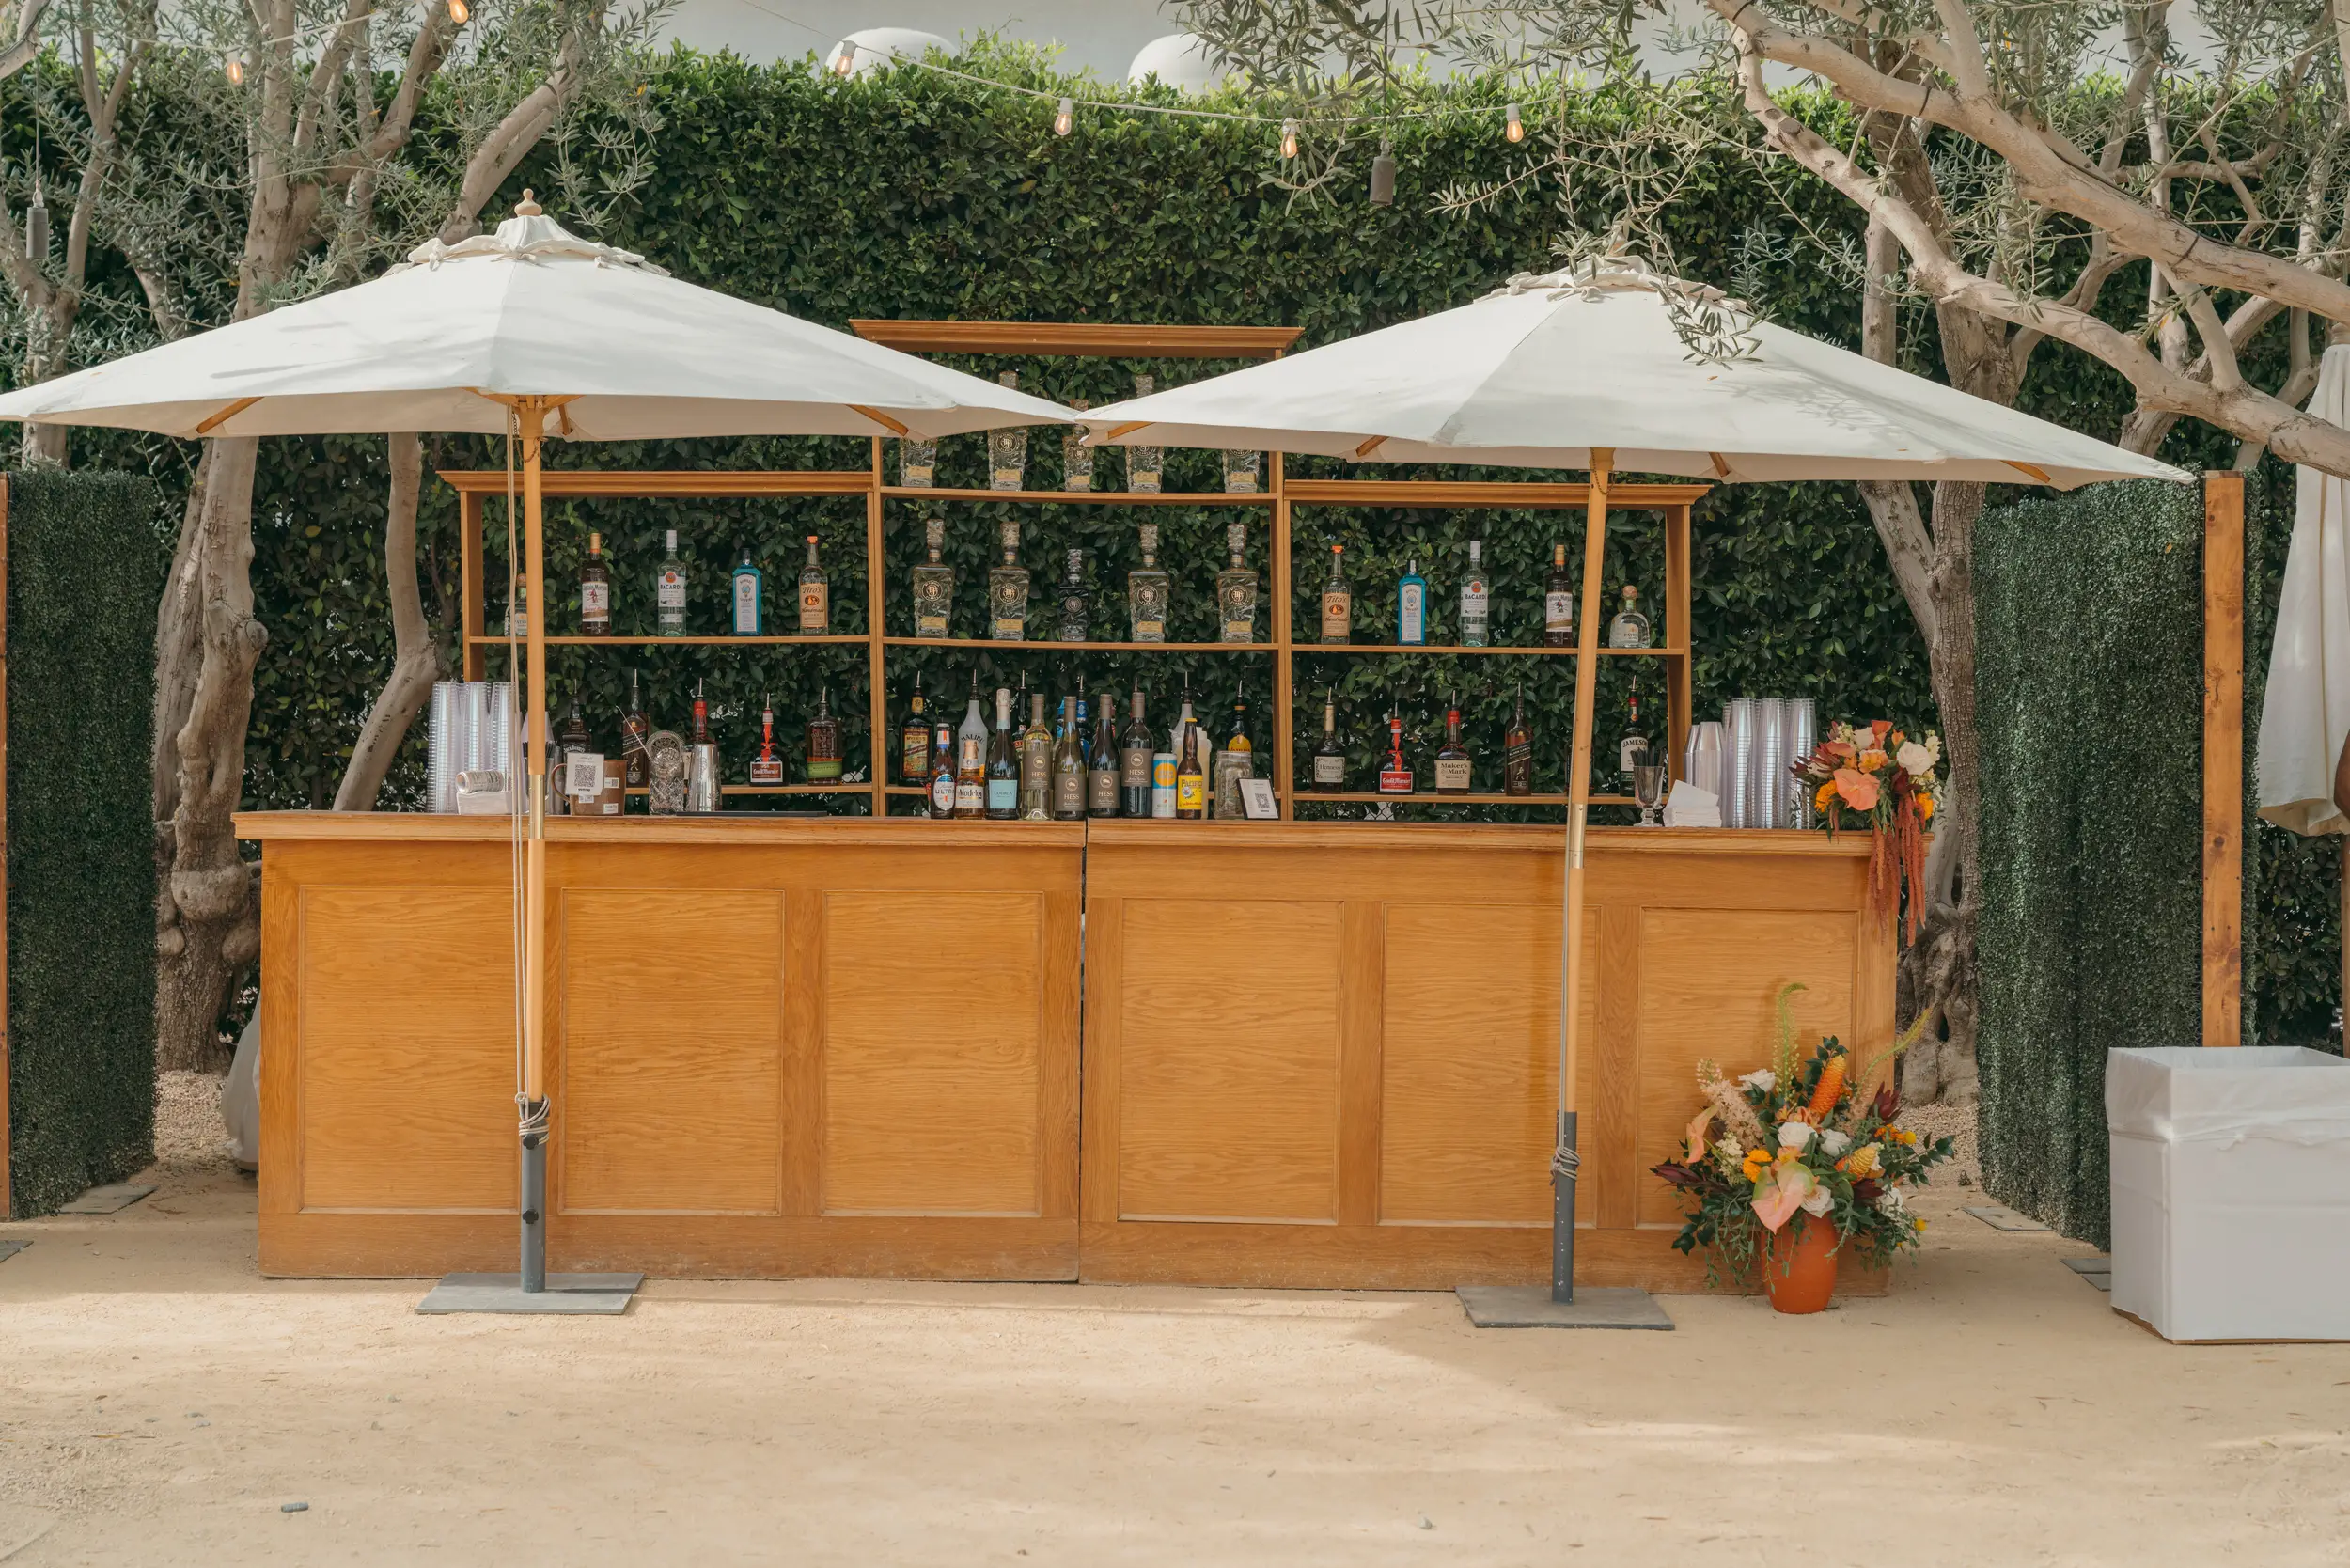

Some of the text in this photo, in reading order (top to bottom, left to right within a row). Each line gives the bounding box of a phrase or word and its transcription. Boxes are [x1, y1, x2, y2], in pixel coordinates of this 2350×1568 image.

[803, 586, 822, 594] Tito's
[1327, 595, 1347, 604] Tito's
[961, 734, 985, 745] MALIBU
